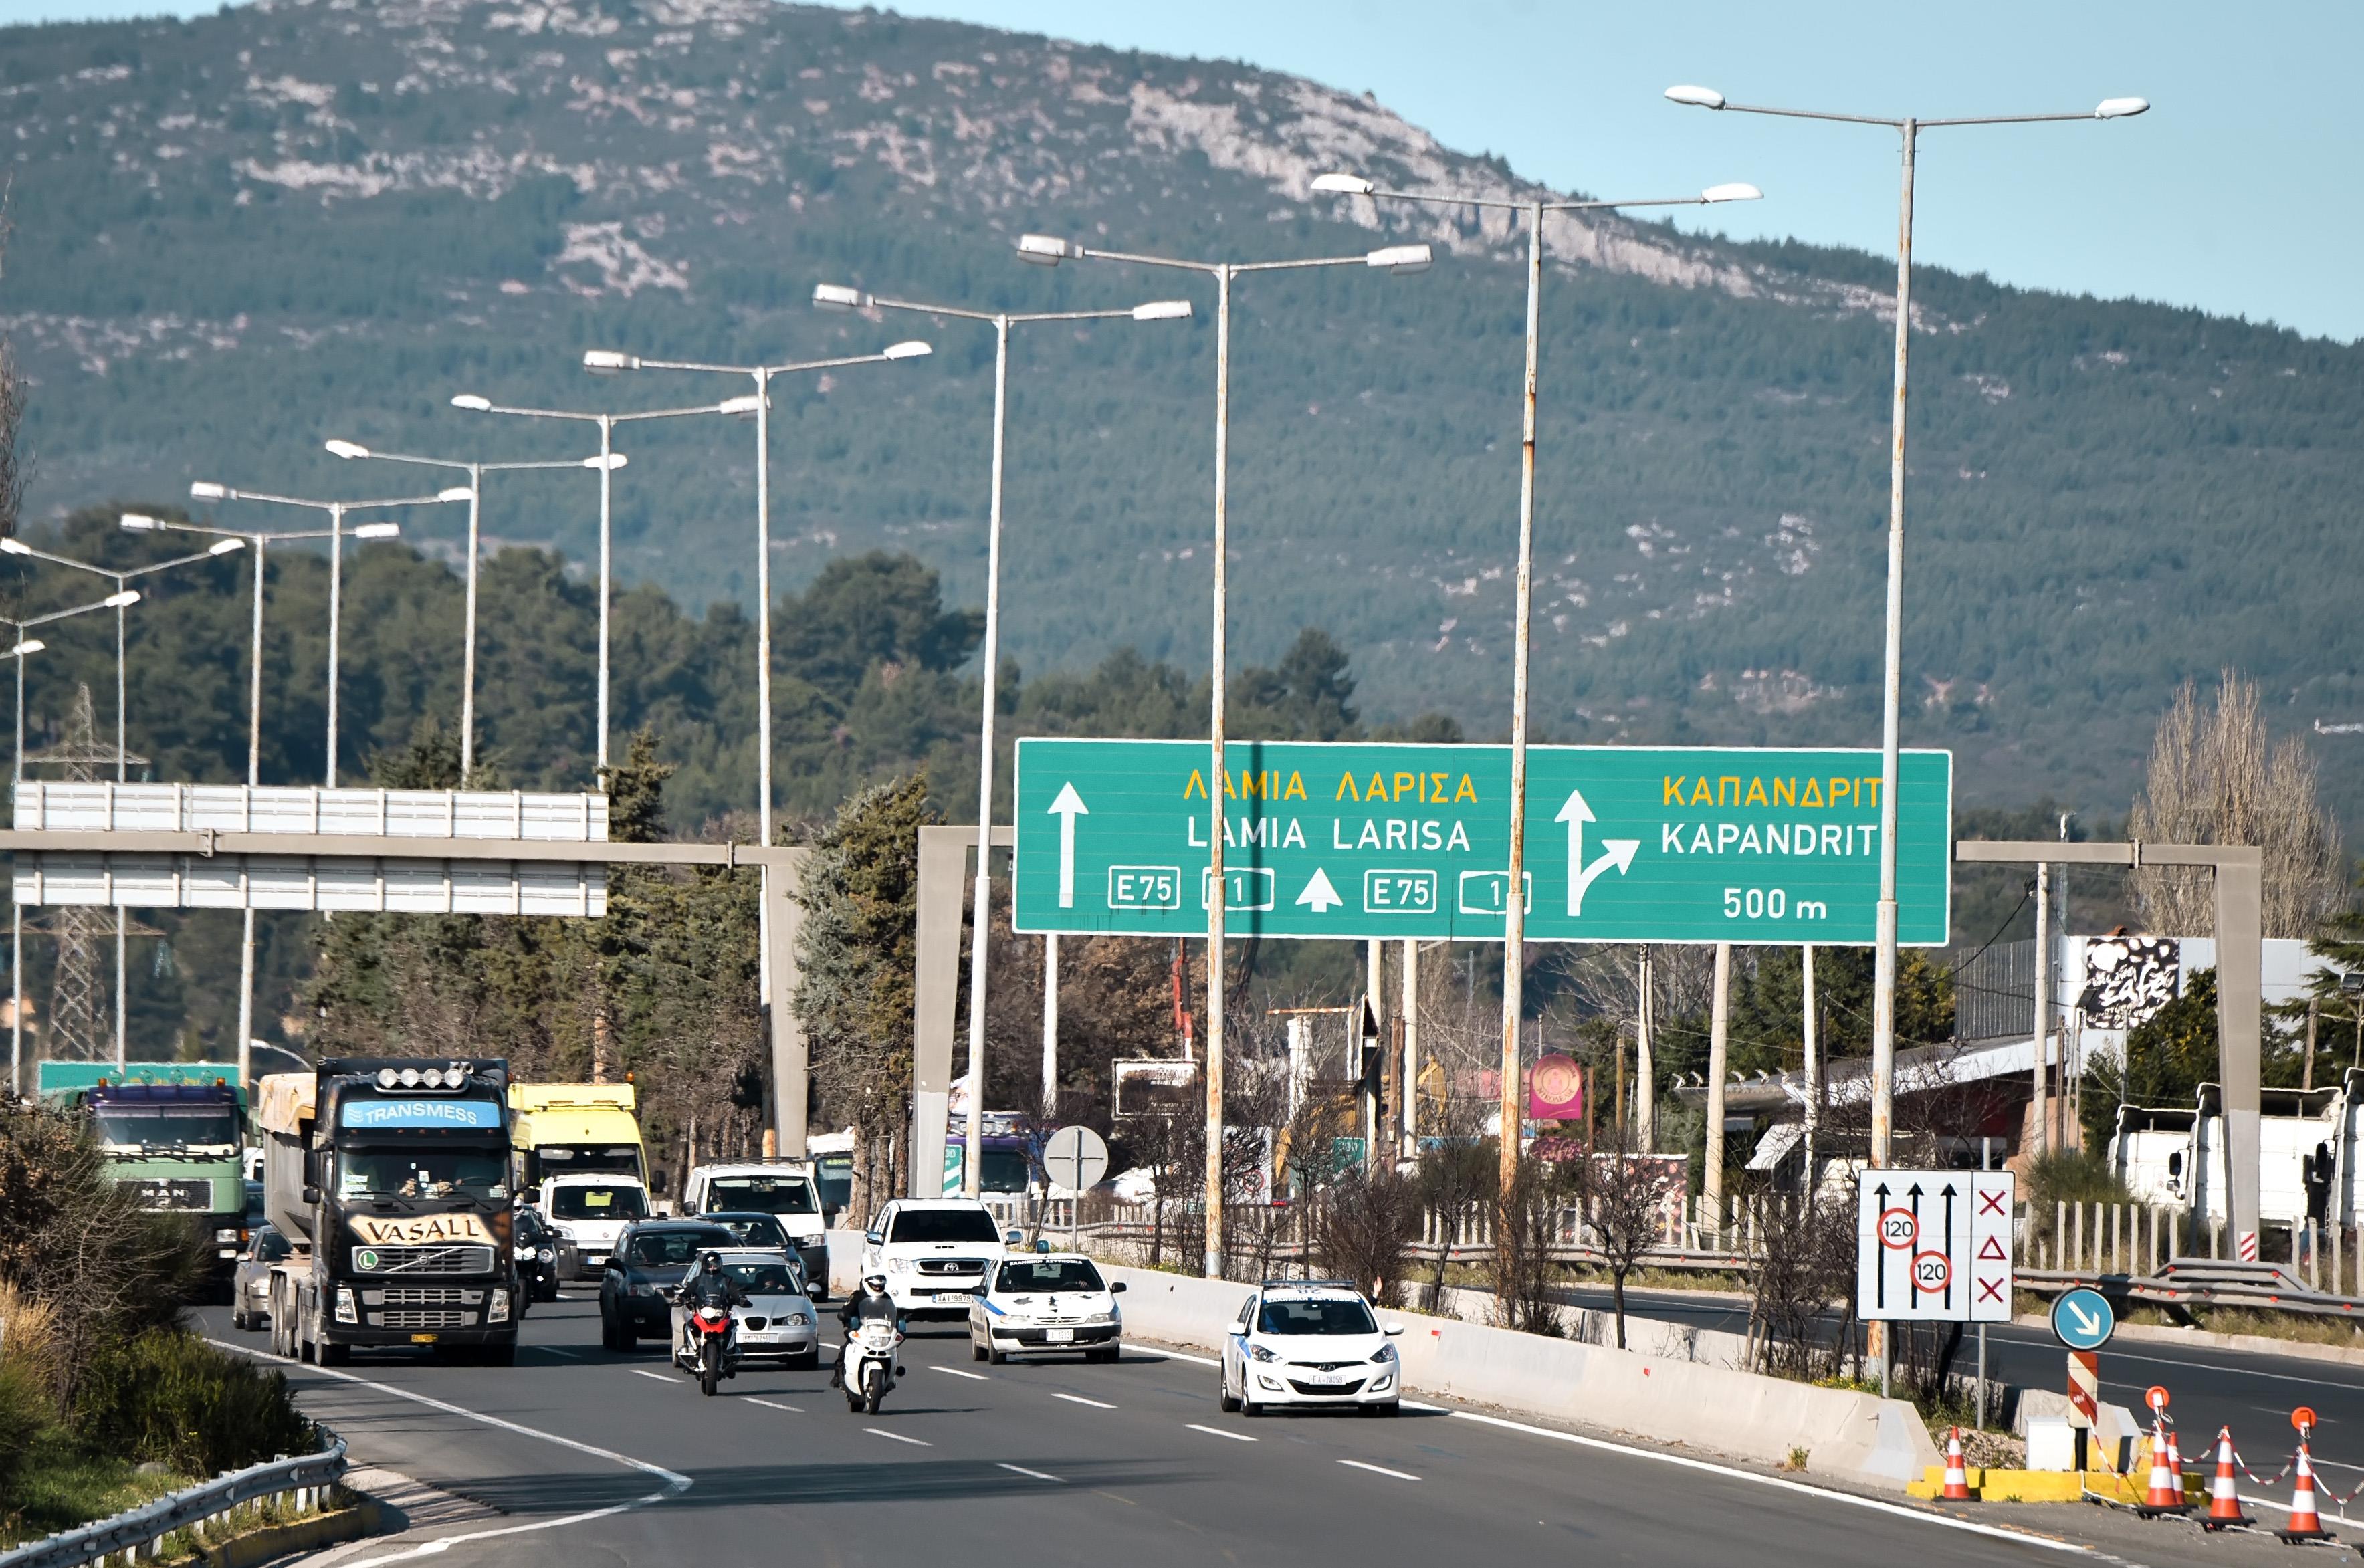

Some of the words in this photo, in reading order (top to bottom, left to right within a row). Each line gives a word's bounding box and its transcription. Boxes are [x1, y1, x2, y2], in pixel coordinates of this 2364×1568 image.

[1183, 770, 1307, 800] ΛΑΜΙΑ
[1336, 771, 1477, 803] ΛΑΡΙΣΑ
[1188, 816, 1307, 849] LAMIA
[1333, 818, 1471, 851] LARISA
[1234, 877, 1243, 902] 1
[1491, 880, 1499, 906] 1
[1724, 887, 1786, 919] 500
[1796, 901, 1827, 919] m
[365, 1103, 477, 1125] TRANSMESS
[141, 1189, 185, 1197] MAN
[366, 1218, 479, 1241] VASALL
[1885, 1220, 1914, 1238] 120
[363, 1254, 373, 1267] L
[1917, 1263, 1947, 1280] 120
